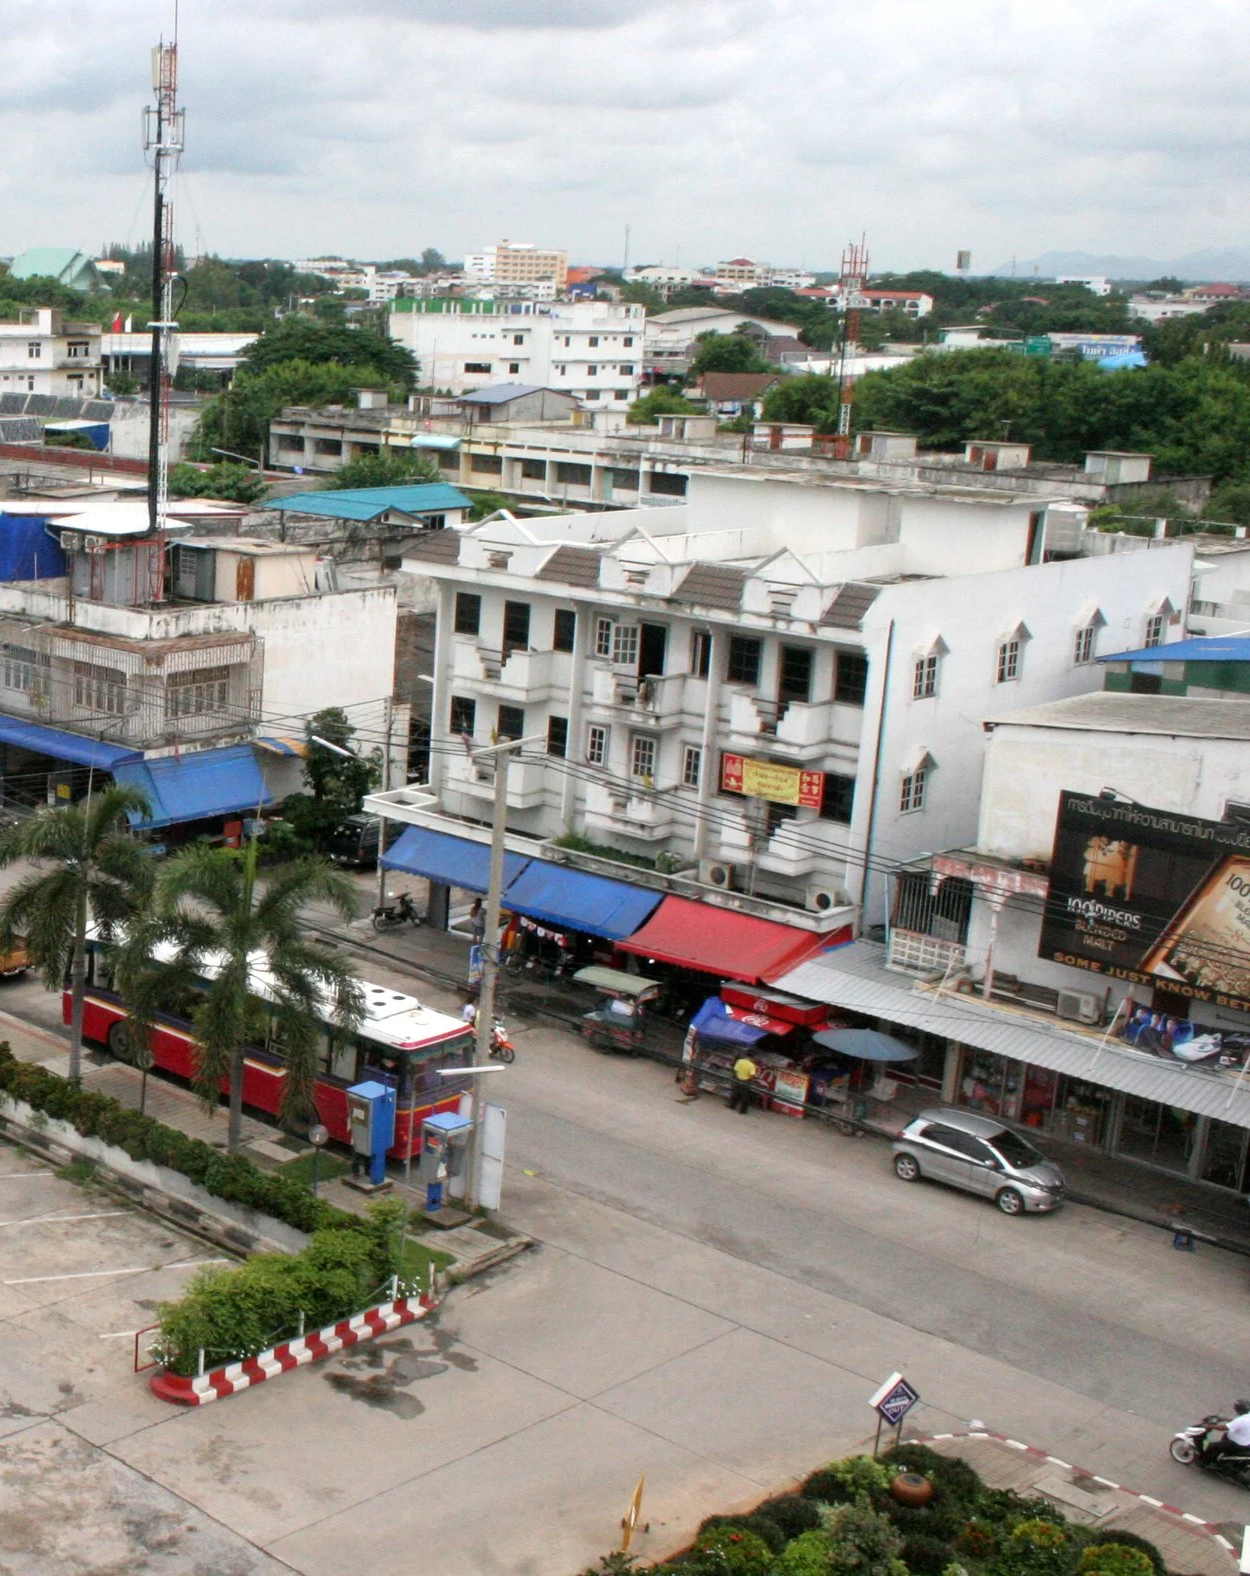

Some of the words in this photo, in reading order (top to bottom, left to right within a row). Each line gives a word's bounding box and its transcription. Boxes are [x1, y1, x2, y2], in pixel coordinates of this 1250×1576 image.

[1082, 935, 1116, 951] MALT
[1053, 951, 1102, 972] SOME
[1106, 966, 1150, 984] JUST
[1155, 978, 1211, 1001] KNOW
